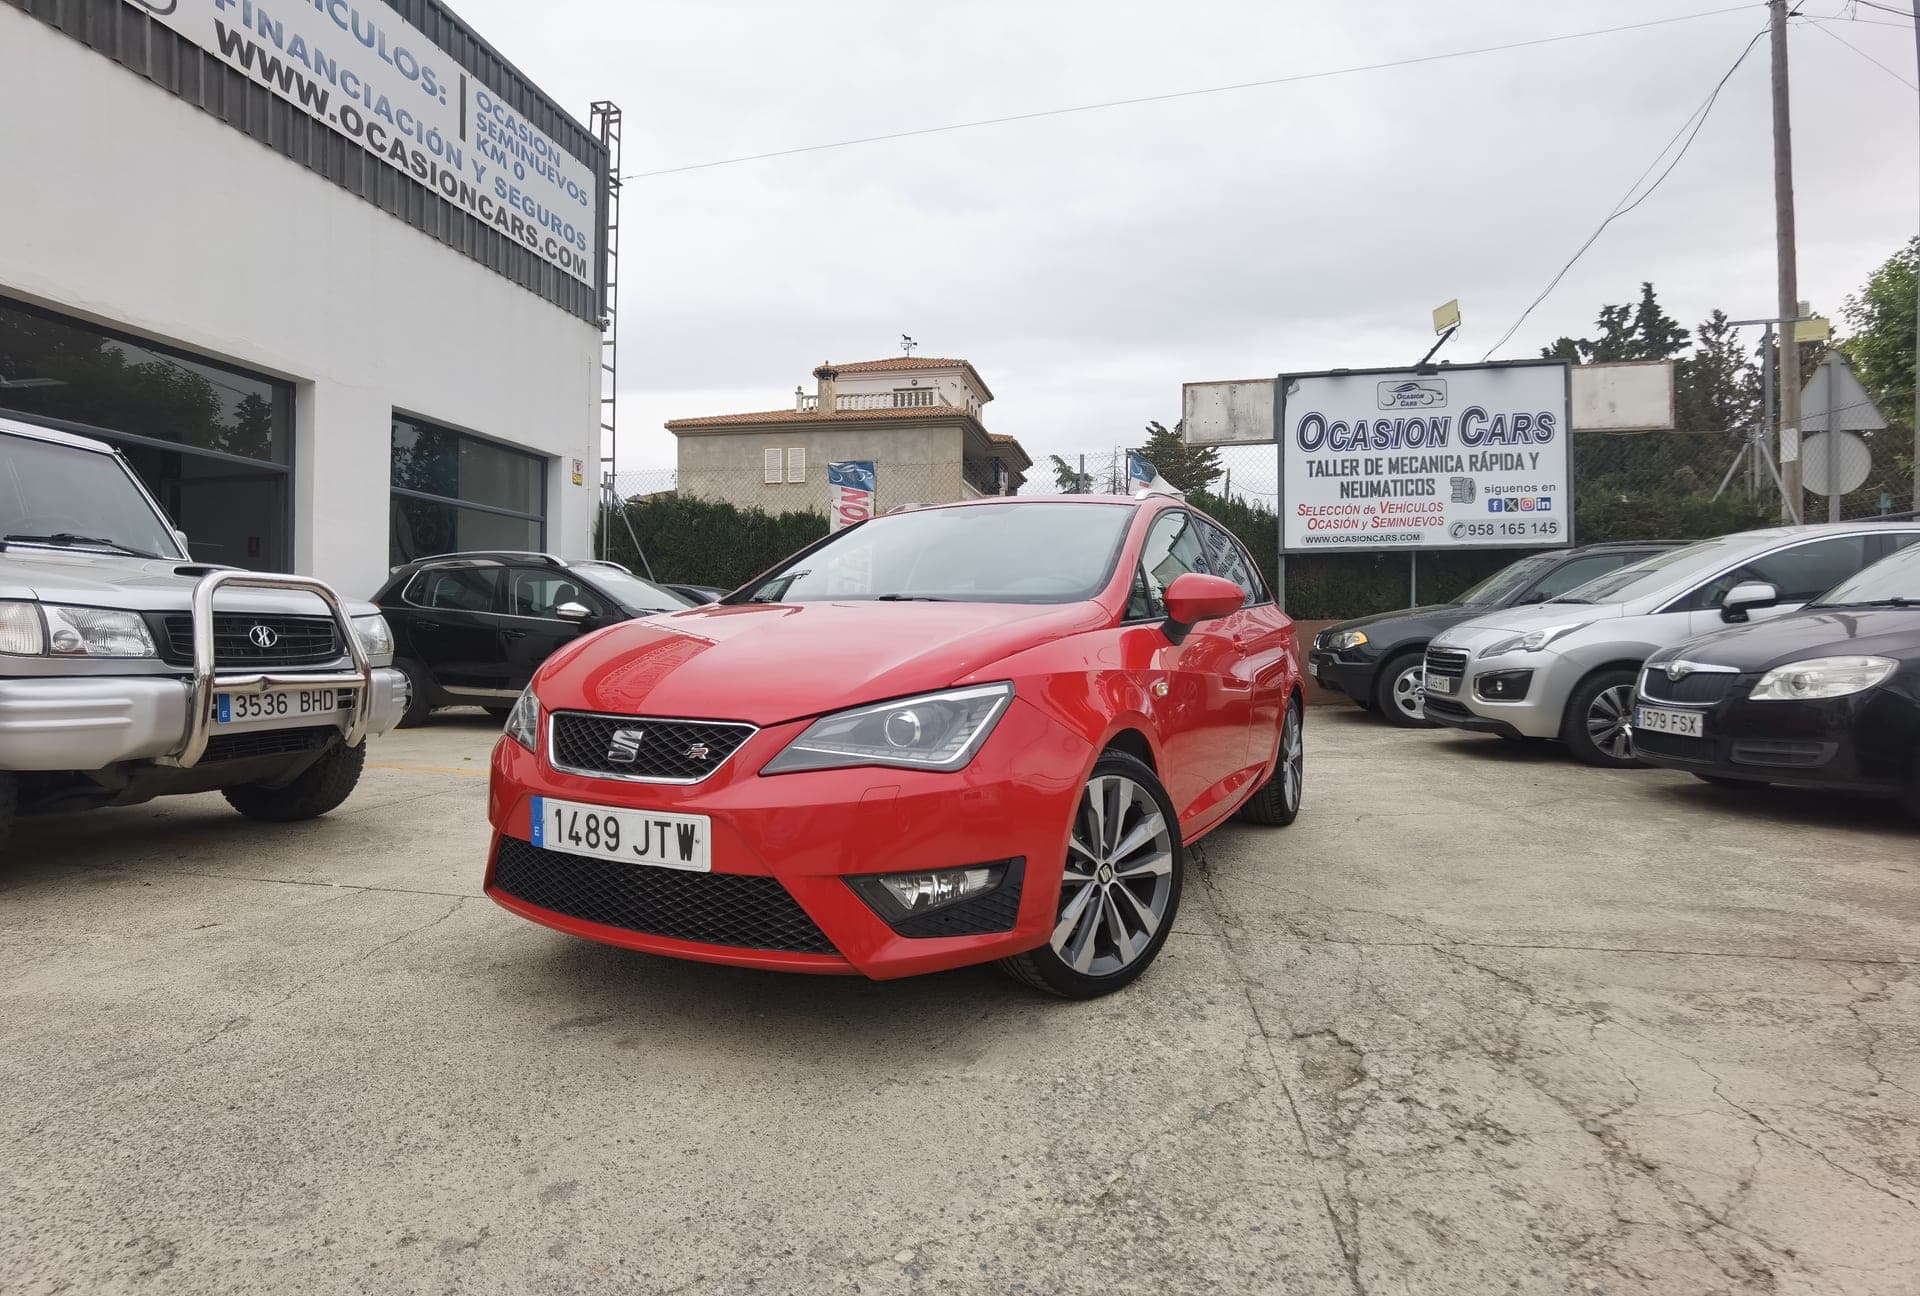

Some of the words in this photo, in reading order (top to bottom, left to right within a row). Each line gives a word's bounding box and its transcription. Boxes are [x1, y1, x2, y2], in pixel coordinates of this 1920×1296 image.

[306, 0, 446, 105] CULOS:
[476, 91, 560, 168] OCASION
[213, 18, 587, 279] WWW.OCASIONCARS.COM
[476, 132, 508, 170] KM
[476, 112, 588, 206] SEMINUEVOS
[472, 158, 487, 184] Y
[494, 176, 587, 251] SEGUROS
[1297, 411, 1451, 452] OCASION
[1458, 405, 1556, 448] CARS
[1306, 458, 1360, 478] TALLER
[1364, 457, 1384, 476] DE
[1388, 454, 1465, 475] MECANICA
[1469, 450, 1524, 472] RÁPIDA
[1528, 452, 1540, 471] Y
[1340, 478, 1436, 499] NEUMATICOS
[1541, 484, 1556, 492] en
[1362, 520, 1368, 531] y
[1371, 515, 1445, 529] SEMINUEVOS
[1363, 504, 1376, 515] de
[1468, 523, 1494, 536] 958
[1499, 522, 1526, 535] 165
[1531, 522, 1557, 534] 145
[221, 710, 228, 718] E
[235, 693, 288, 718] 3536
[300, 689, 334, 713] BHD
[1642, 710, 1666, 729] 1579
[1671, 714, 1697, 734] FSX
[534, 826, 540, 836] E
[555, 808, 620, 852] 1489
[632, 819, 696, 862] JTW
